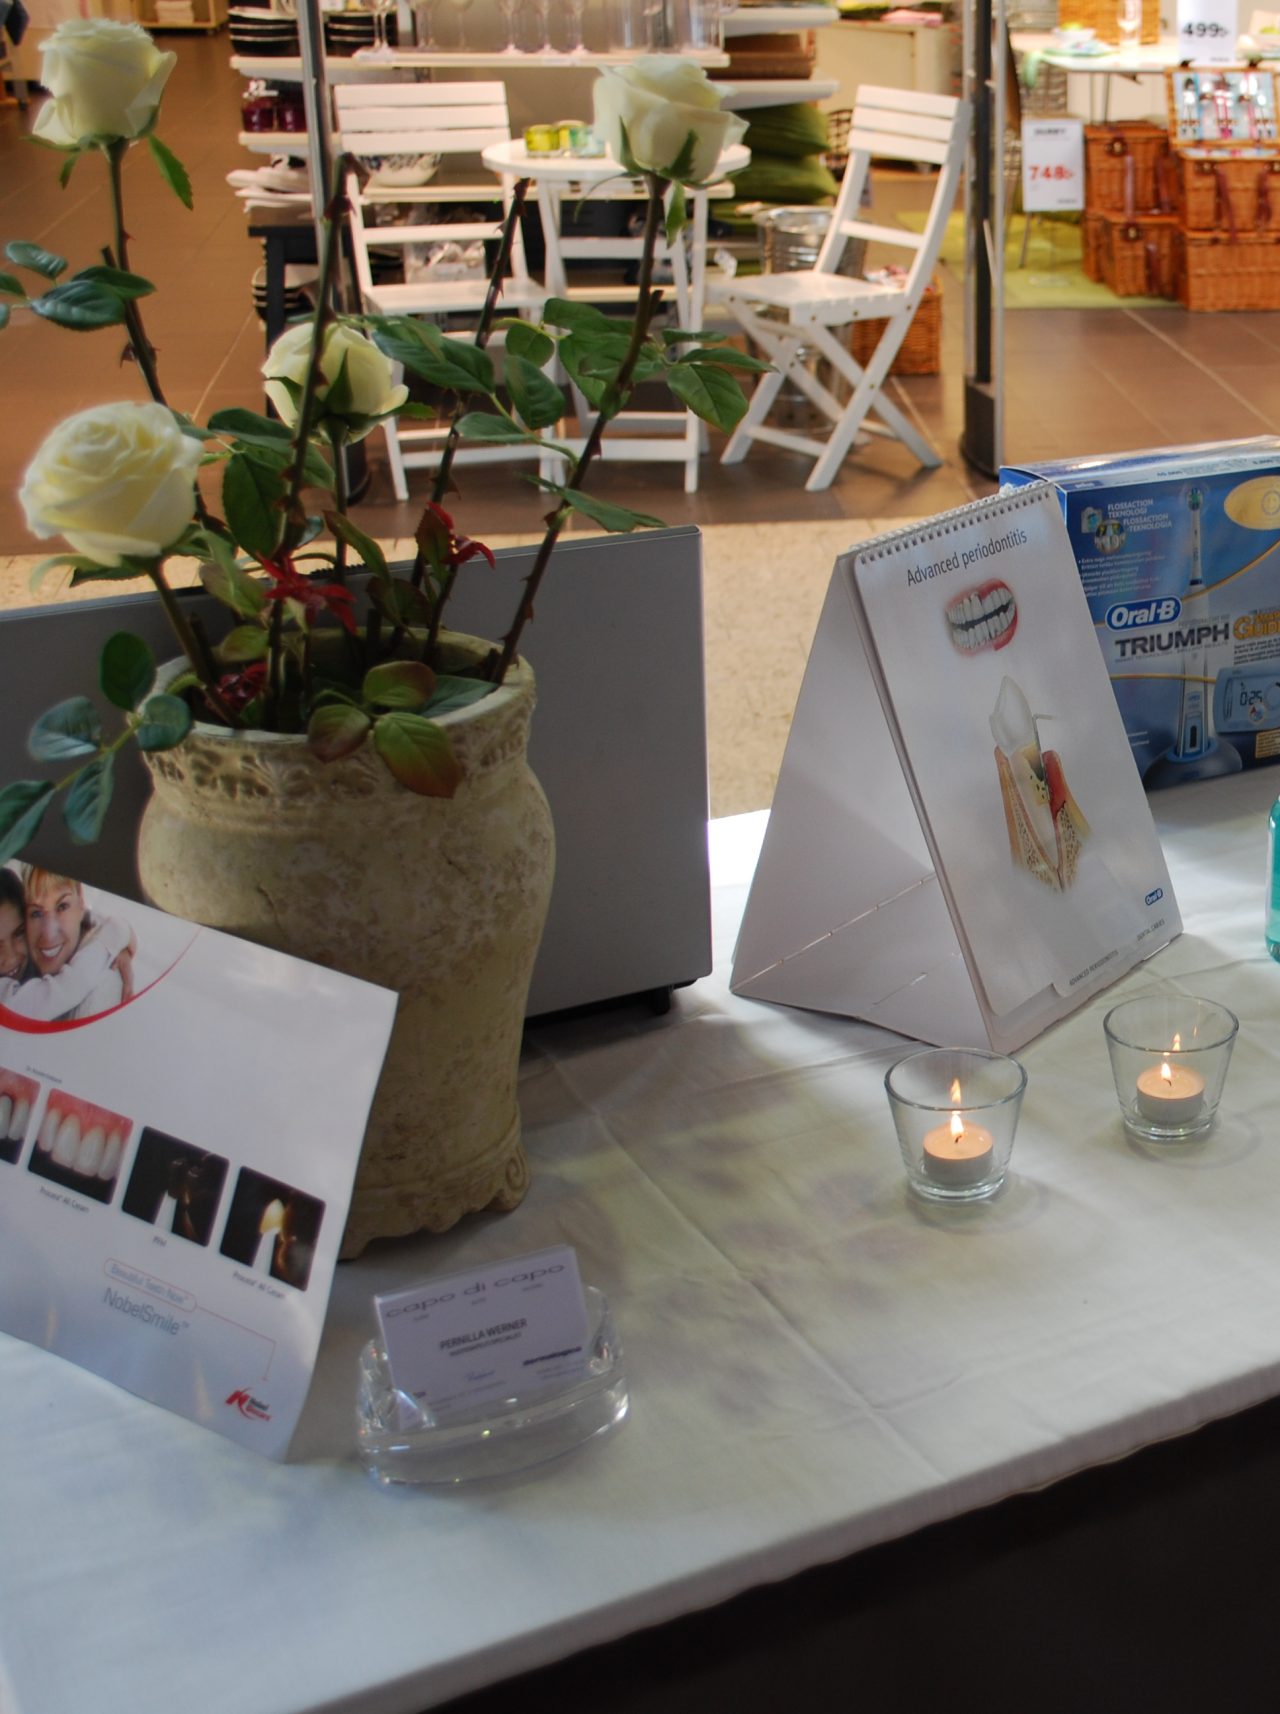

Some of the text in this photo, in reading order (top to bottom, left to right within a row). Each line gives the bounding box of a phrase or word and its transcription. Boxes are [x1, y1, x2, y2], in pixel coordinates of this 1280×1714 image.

[1107, 498, 1154, 511] FLOSSACTION
[1107, 507, 1148, 519] TEKNOLOGI
[1123, 513, 1169, 526] FLOSSACTION
[907, 528, 1028, 586] Advanced periodontitis
[1111, 600, 1176, 627] Oral-B
[1115, 622, 1229, 657] TRIUMPH
[386, 1264, 565, 1318] capo di capo
[439, 1329, 485, 1351] PERNILLA
[485, 1317, 528, 1337] WERNER
